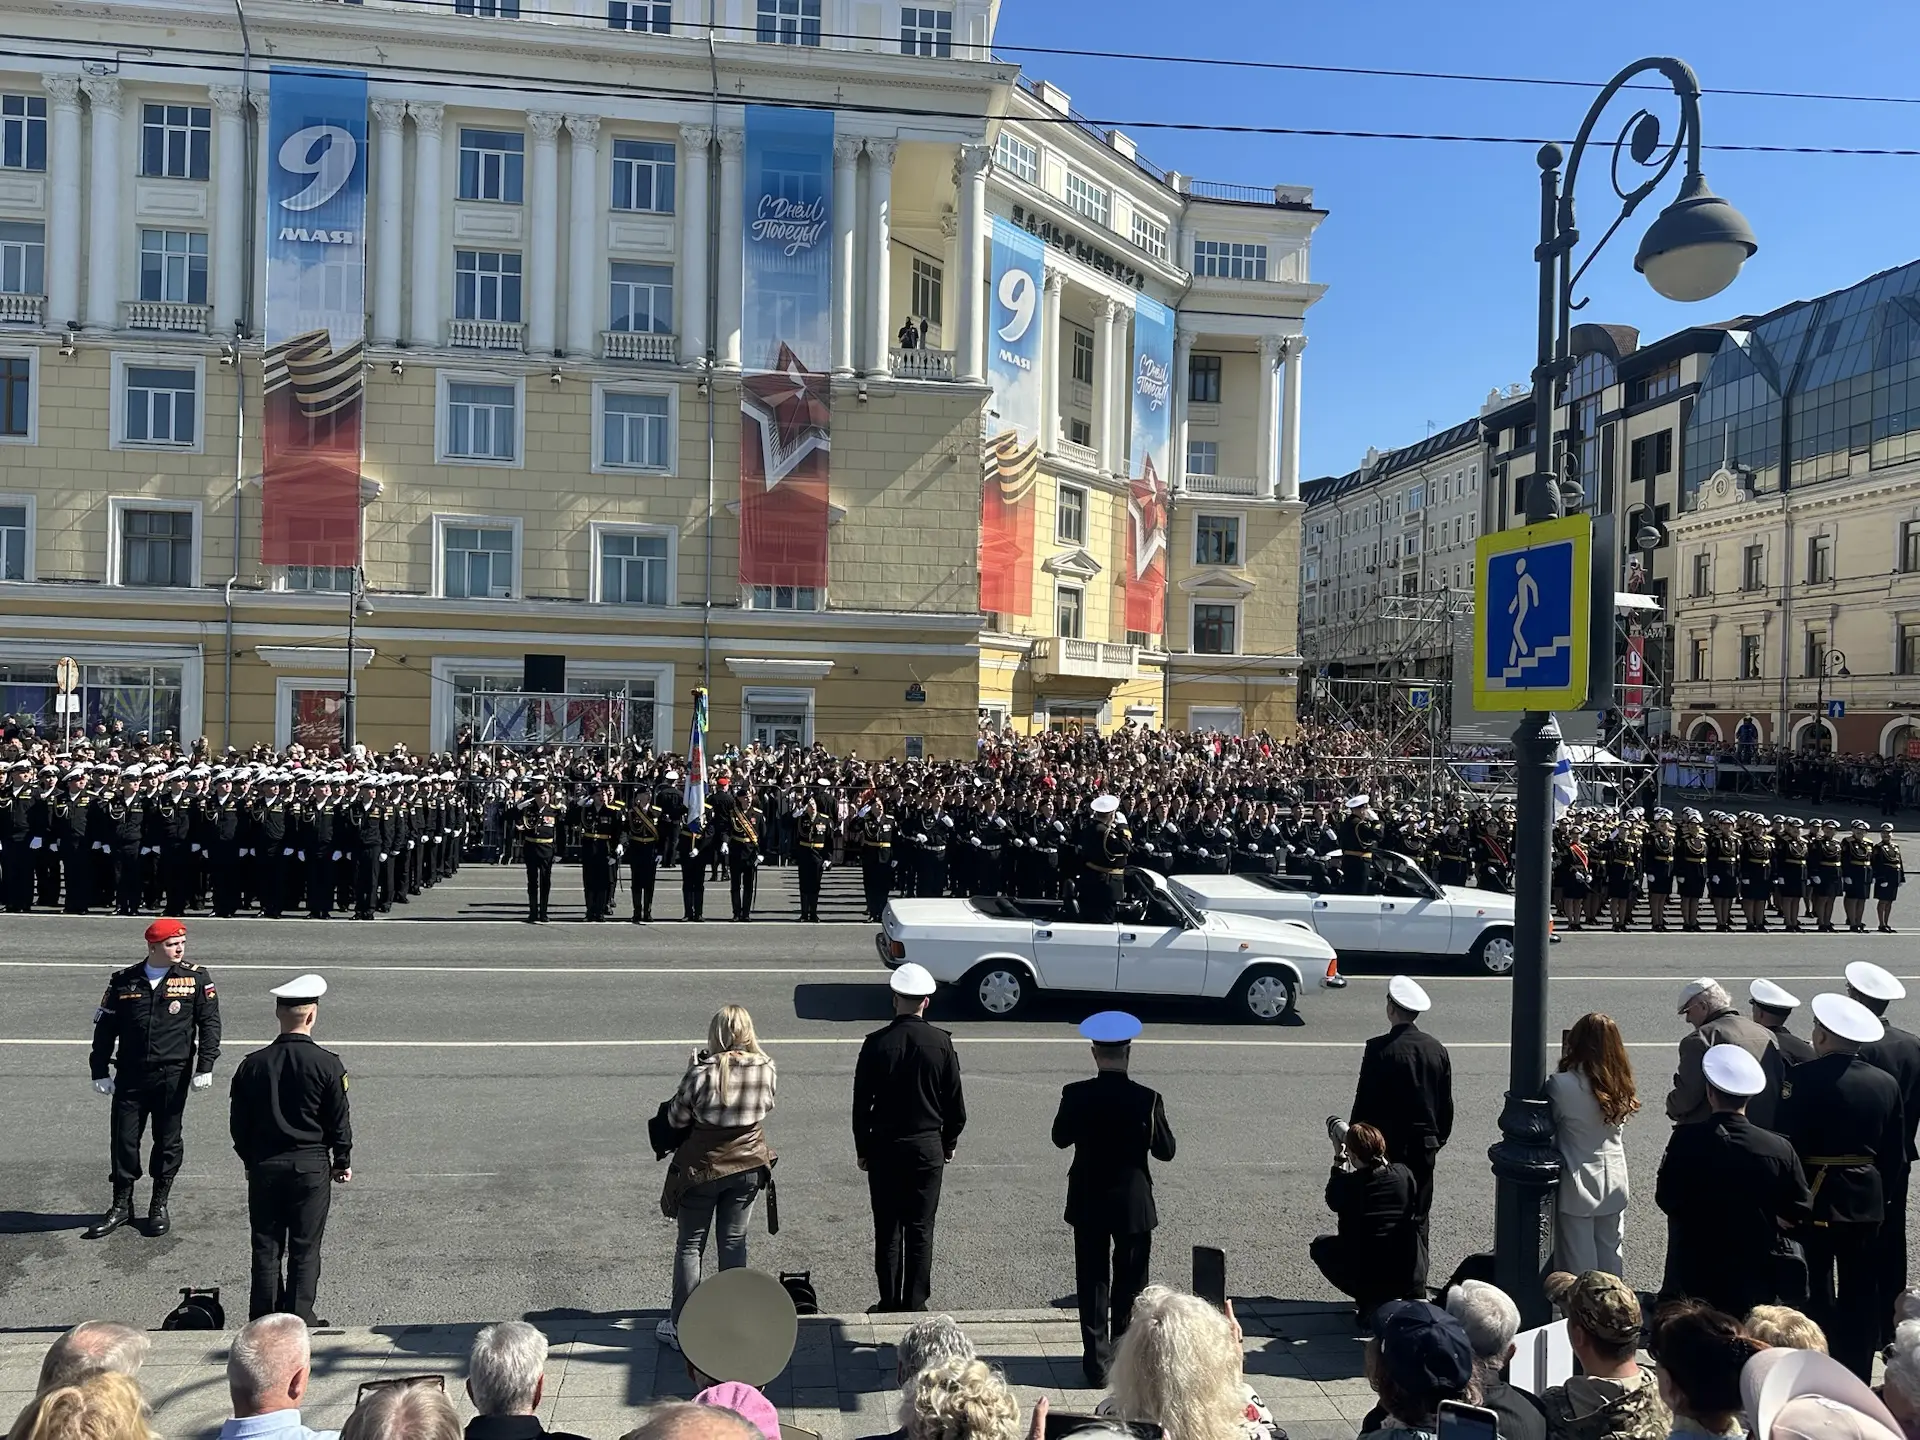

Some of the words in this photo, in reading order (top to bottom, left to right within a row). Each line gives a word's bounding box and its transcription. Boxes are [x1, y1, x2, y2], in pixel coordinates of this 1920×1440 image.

[279, 125, 357, 211] 9
[758, 194, 771, 219] С
[279, 227, 353, 244] МАЯ
[998, 269, 1036, 342] 9
[999, 348, 1031, 370] МАЯ
[1630, 650, 1641, 671] 9
